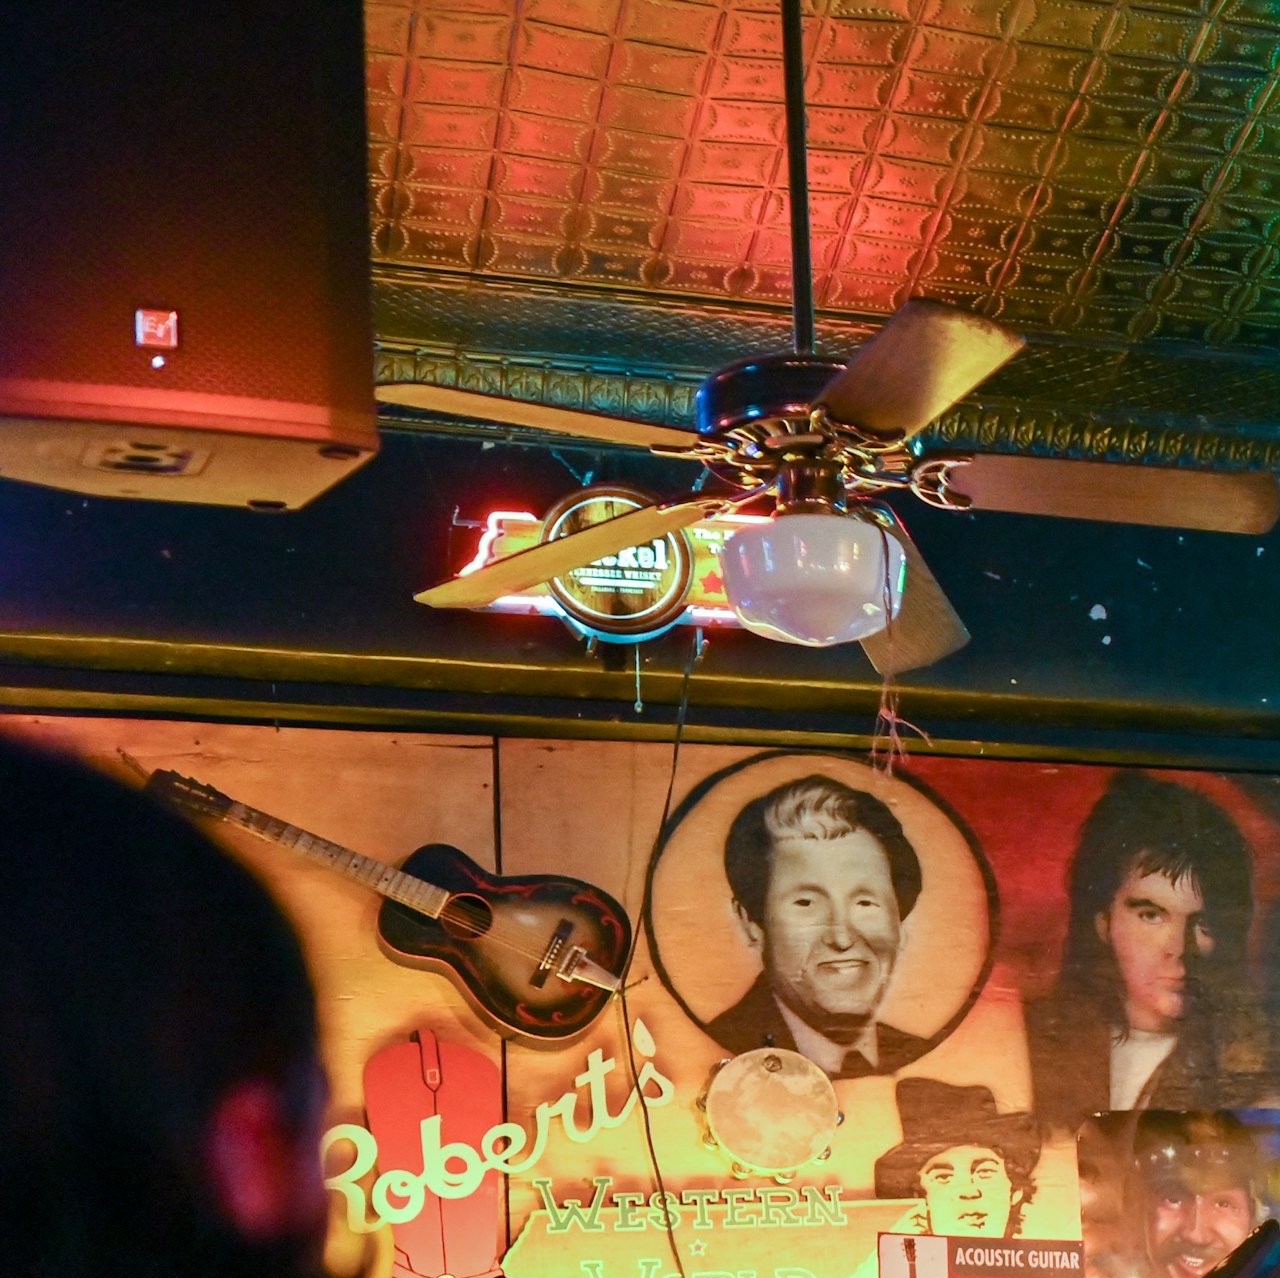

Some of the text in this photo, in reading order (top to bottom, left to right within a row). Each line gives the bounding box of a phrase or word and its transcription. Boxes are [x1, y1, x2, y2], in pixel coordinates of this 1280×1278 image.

[320, 1017, 675, 1234] Robert's
[532, 1176, 848, 1232] WESTERN
[955, 1247, 1080, 1269] ACOUSTIC GUITAR
